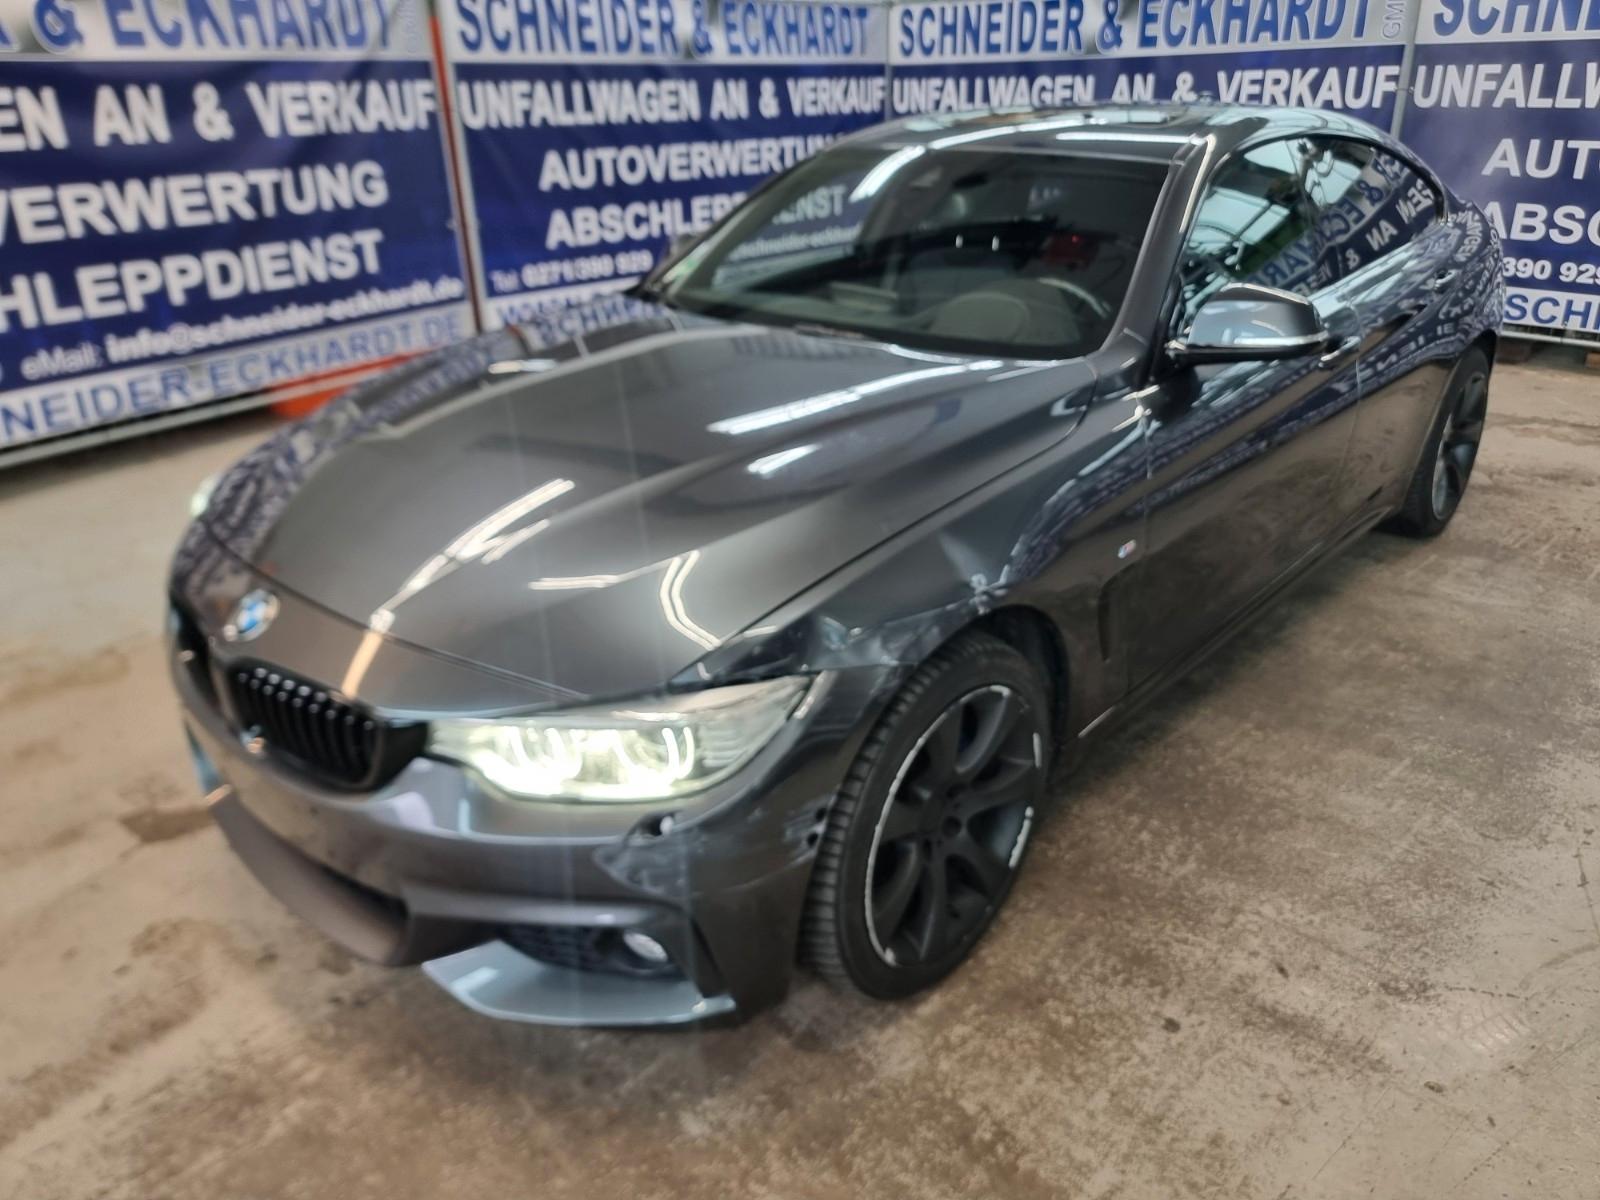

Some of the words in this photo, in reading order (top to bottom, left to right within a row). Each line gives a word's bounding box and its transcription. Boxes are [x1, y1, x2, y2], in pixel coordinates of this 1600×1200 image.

[34, 0, 83, 48] &
[457, 0, 681, 52] SCHNEIDER
[692, 0, 713, 53] &
[723, 1, 868, 54] ECKHARDT
[900, 0, 1085, 57] SCHNEIDER
[1101, 0, 1124, 50] &
[1137, 0, 1369, 49] ECKHARDT
[1432, 0, 1600, 37] SCHN
[93, 84, 172, 147] AN
[192, 81, 235, 142] &
[245, 78, 438, 139] VERKAUF
[458, 78, 701, 130] UNFALLWAGEN
[710, 77, 750, 121] AN
[759, 77, 781, 119] &
[786, 76, 886, 117] VERKAUF
[893, 74, 1095, 114] UNFALLWAGEN
[1111, 73, 1156, 104] AN
[1172, 71, 1199, 104] &
[1217, 65, 1400, 109] VERKAUF
[1481, 138, 1600, 180] AUT
[1559, 261, 1600, 286] 92
[1504, 293, 1600, 331] SCH
